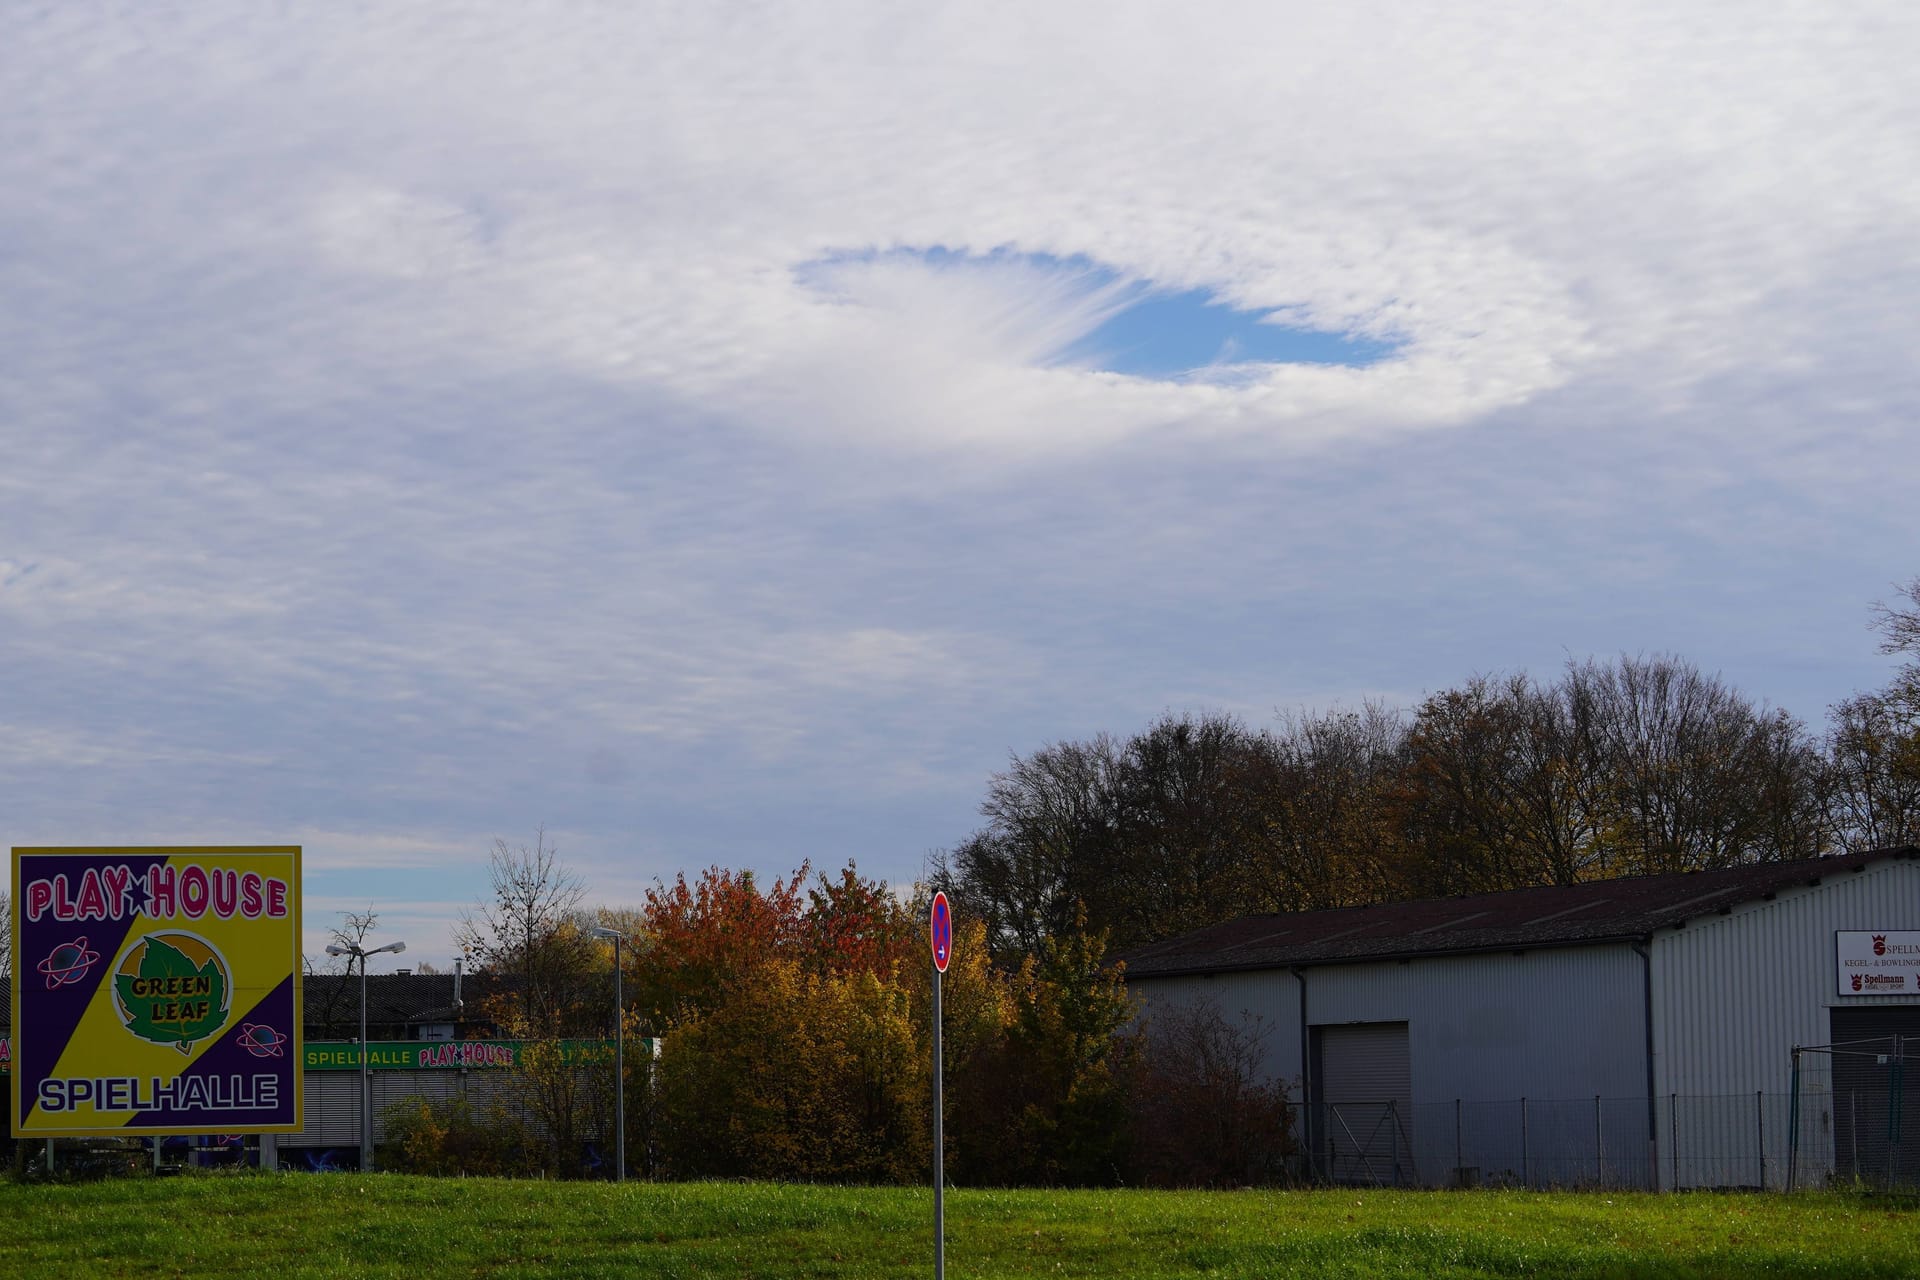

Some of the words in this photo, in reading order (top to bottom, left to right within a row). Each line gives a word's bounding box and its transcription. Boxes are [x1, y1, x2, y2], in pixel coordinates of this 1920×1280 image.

[27, 864, 129, 921] PLAY
[149, 863, 289, 920] HOUSE
[131, 976, 211, 997] GREEN
[1864, 974, 1905, 984] Spellmann
[151, 1001, 210, 1023] LEAF
[419, 1044, 456, 1067] PLAY
[38, 1073, 279, 1112] SPIELHALLE
